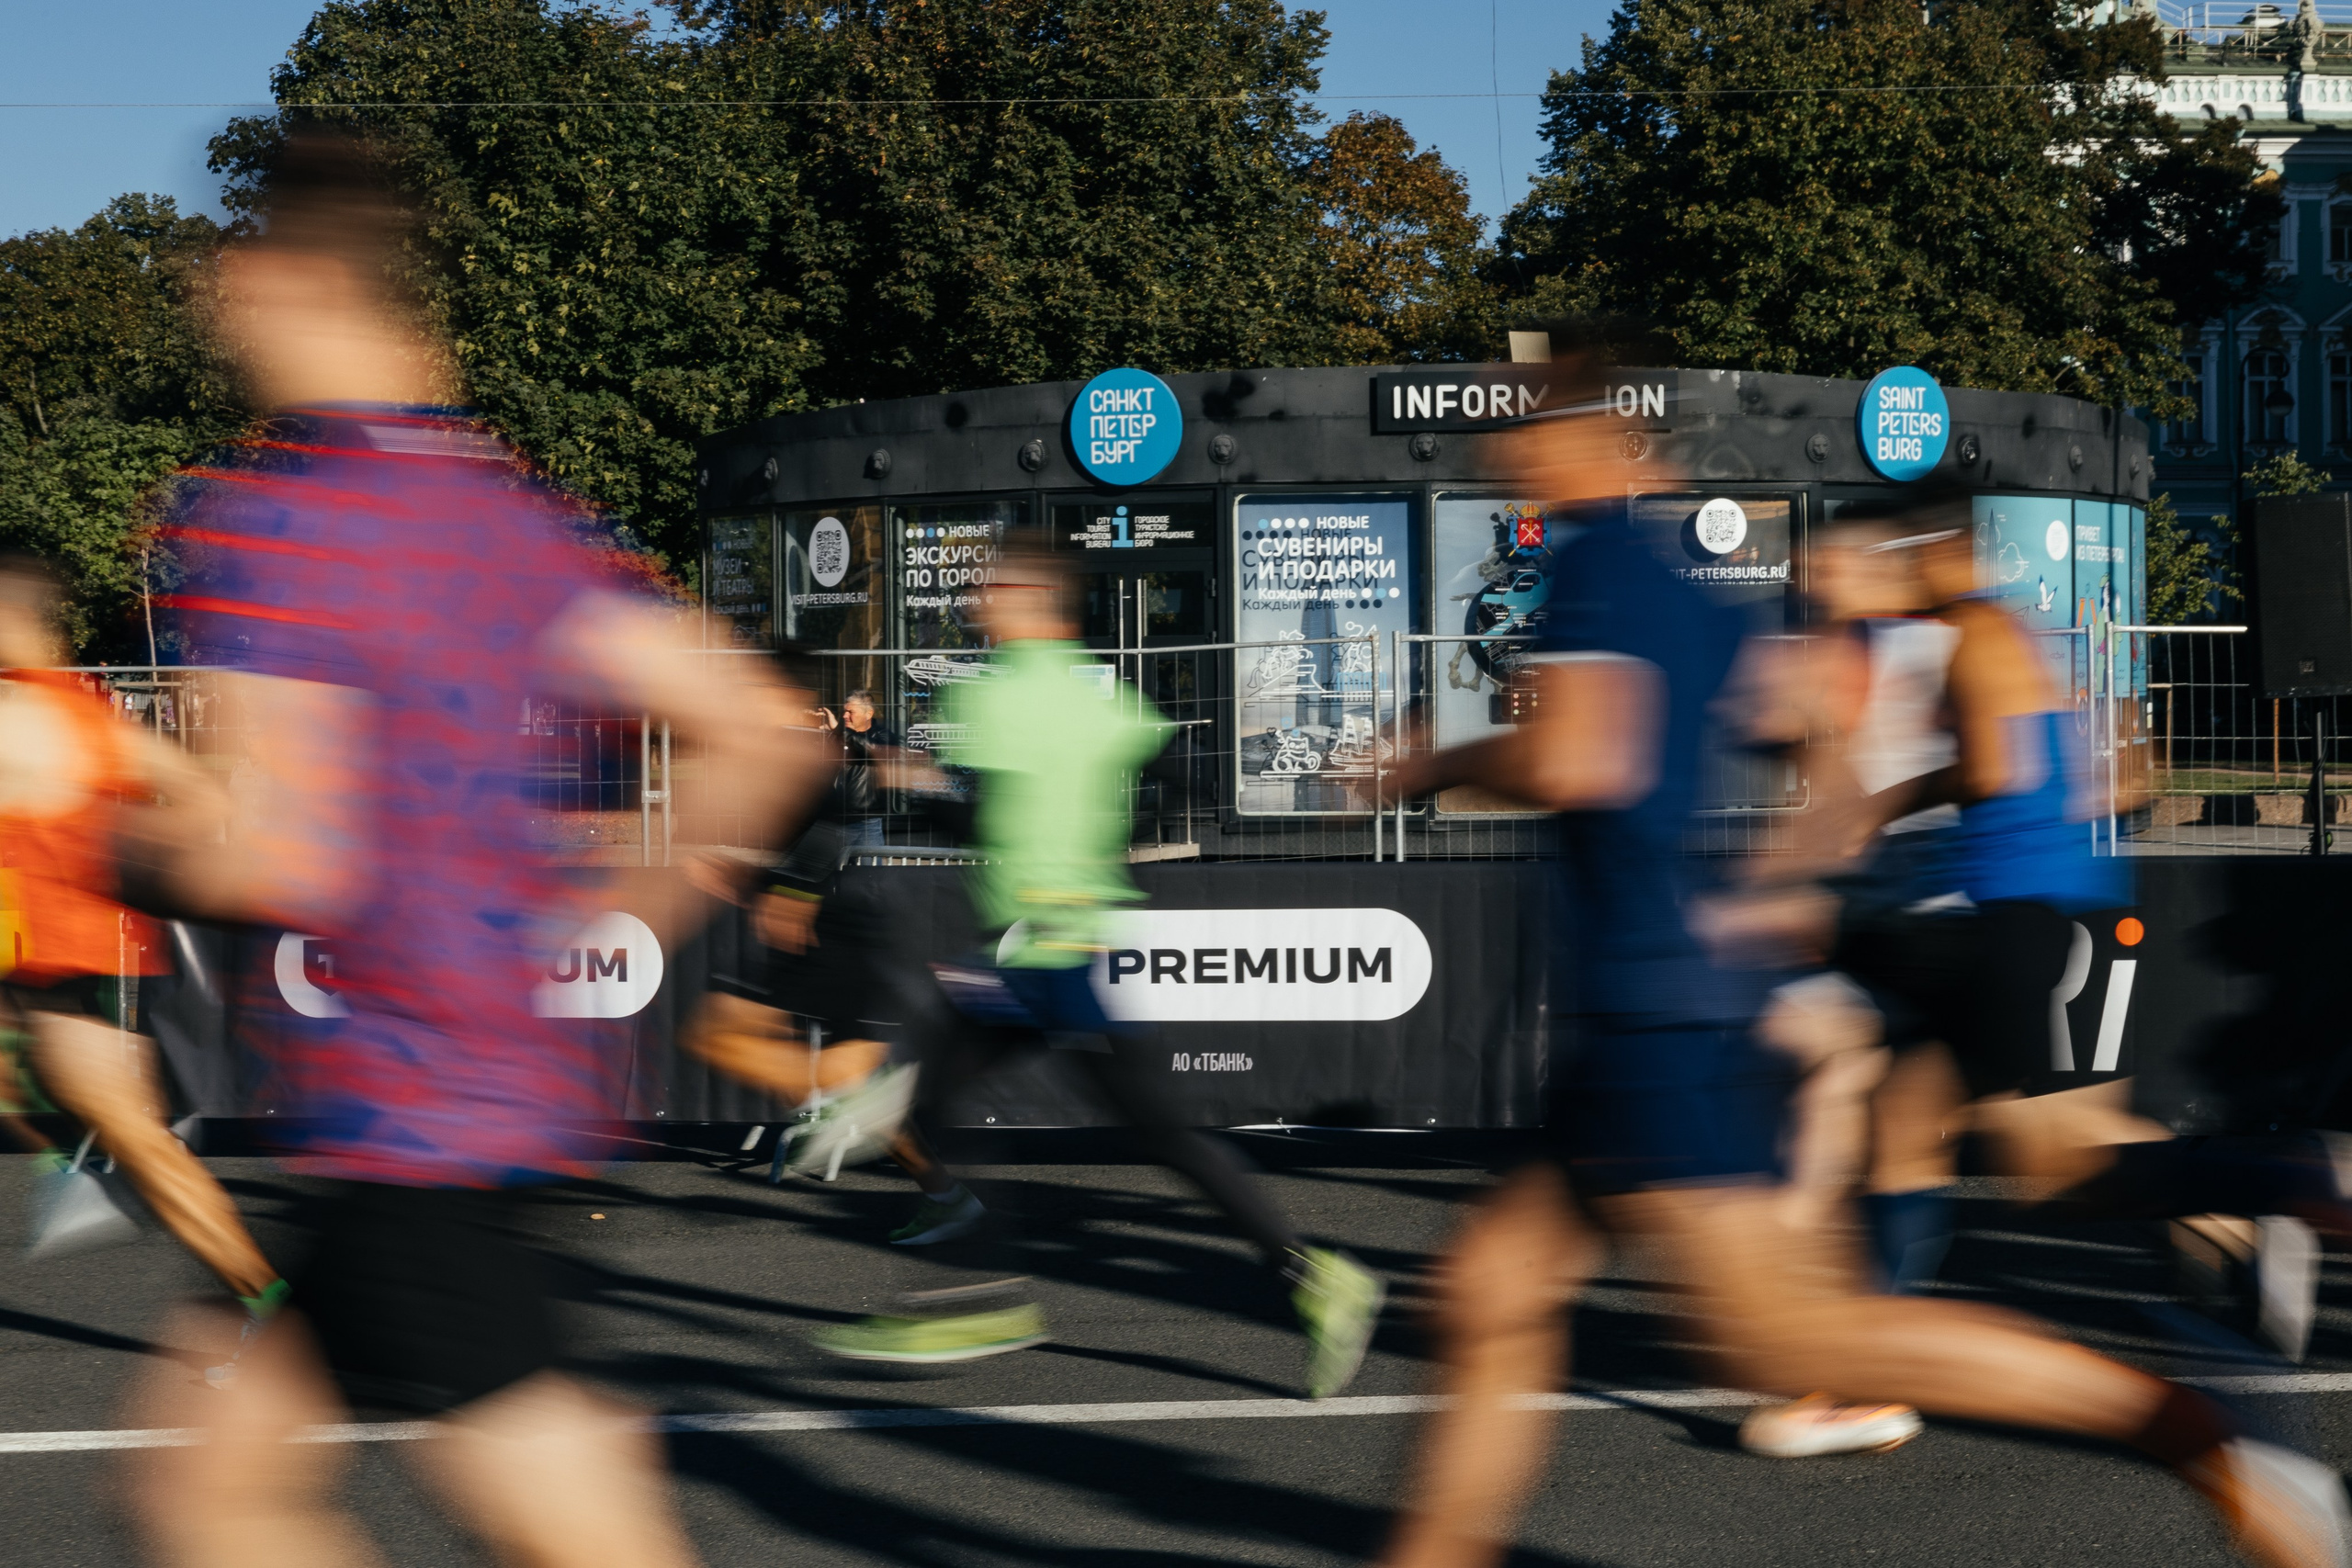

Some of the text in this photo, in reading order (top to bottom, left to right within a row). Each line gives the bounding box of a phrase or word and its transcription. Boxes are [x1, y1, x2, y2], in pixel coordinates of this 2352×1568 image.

[1090, 388, 1155, 412] САНКТ
[1393, 384, 1665, 419] INFORMION
[1879, 386, 1926, 410] SAINT
[1091, 413, 1156, 438] ПЕТЕР
[1878, 412, 1941, 436] PETERS
[1091, 440, 1142, 464] БУРГ
[1878, 437, 1922, 461] BURG
[1135, 515, 1170, 524] ГОРОДСКОЕ
[1317, 515, 1370, 529] НОВЫЕ
[948, 525, 989, 537] НОВЫЕ
[1070, 533, 1112, 541] INFORMATION
[1135, 531, 1194, 539] ИНФОРМАЦИОННОЕ
[1085, 540, 1111, 548] BUREAU
[1135, 539, 1154, 547] БЮРО
[1257, 536, 1383, 557] СУВЕНИРЫ
[906, 567, 996, 588] ПО ГОРОД
[1258, 559, 1396, 582] И ПОДАРКИ
[789, 592, 868, 605] VISIT-PETERSBURG.RU
[906, 593, 981, 608] Каждый день
[1258, 585, 1357, 602] Каждый день
[1108, 947, 1393, 985] PREMIUM
[1171, 1053, 1253, 1071] АО «ТБАНК»
